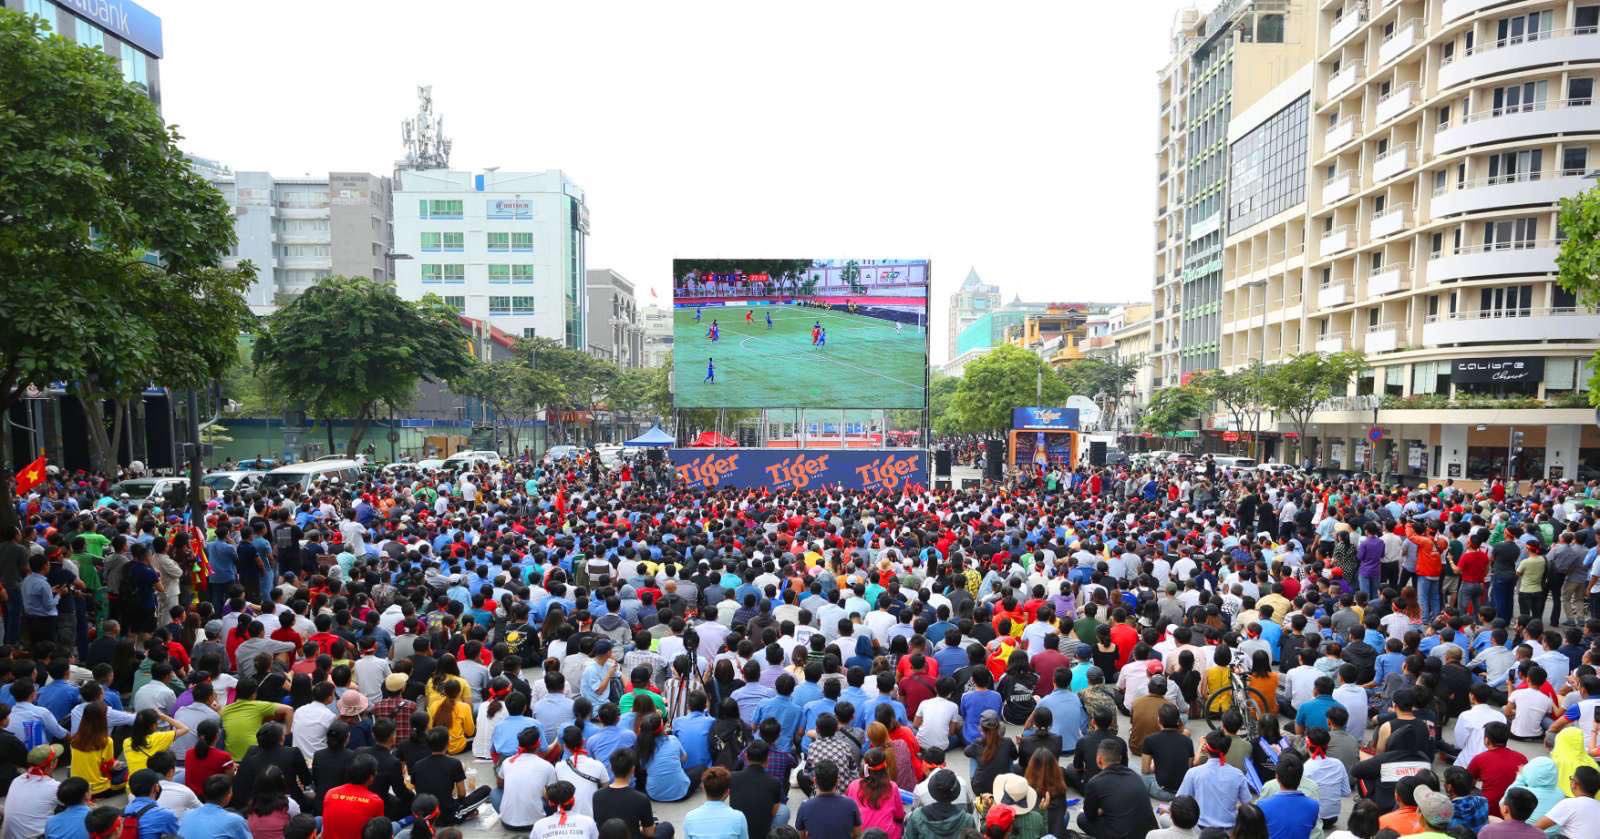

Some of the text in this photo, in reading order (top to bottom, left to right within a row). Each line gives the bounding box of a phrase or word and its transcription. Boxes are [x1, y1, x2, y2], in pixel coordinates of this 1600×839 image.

[1033, 409, 1062, 424] Tiger
[675, 453, 739, 487] Tiger
[766, 453, 829, 488] Tiger
[856, 454, 919, 488] Tiger
[1010, 693, 1031, 702] PUMA
